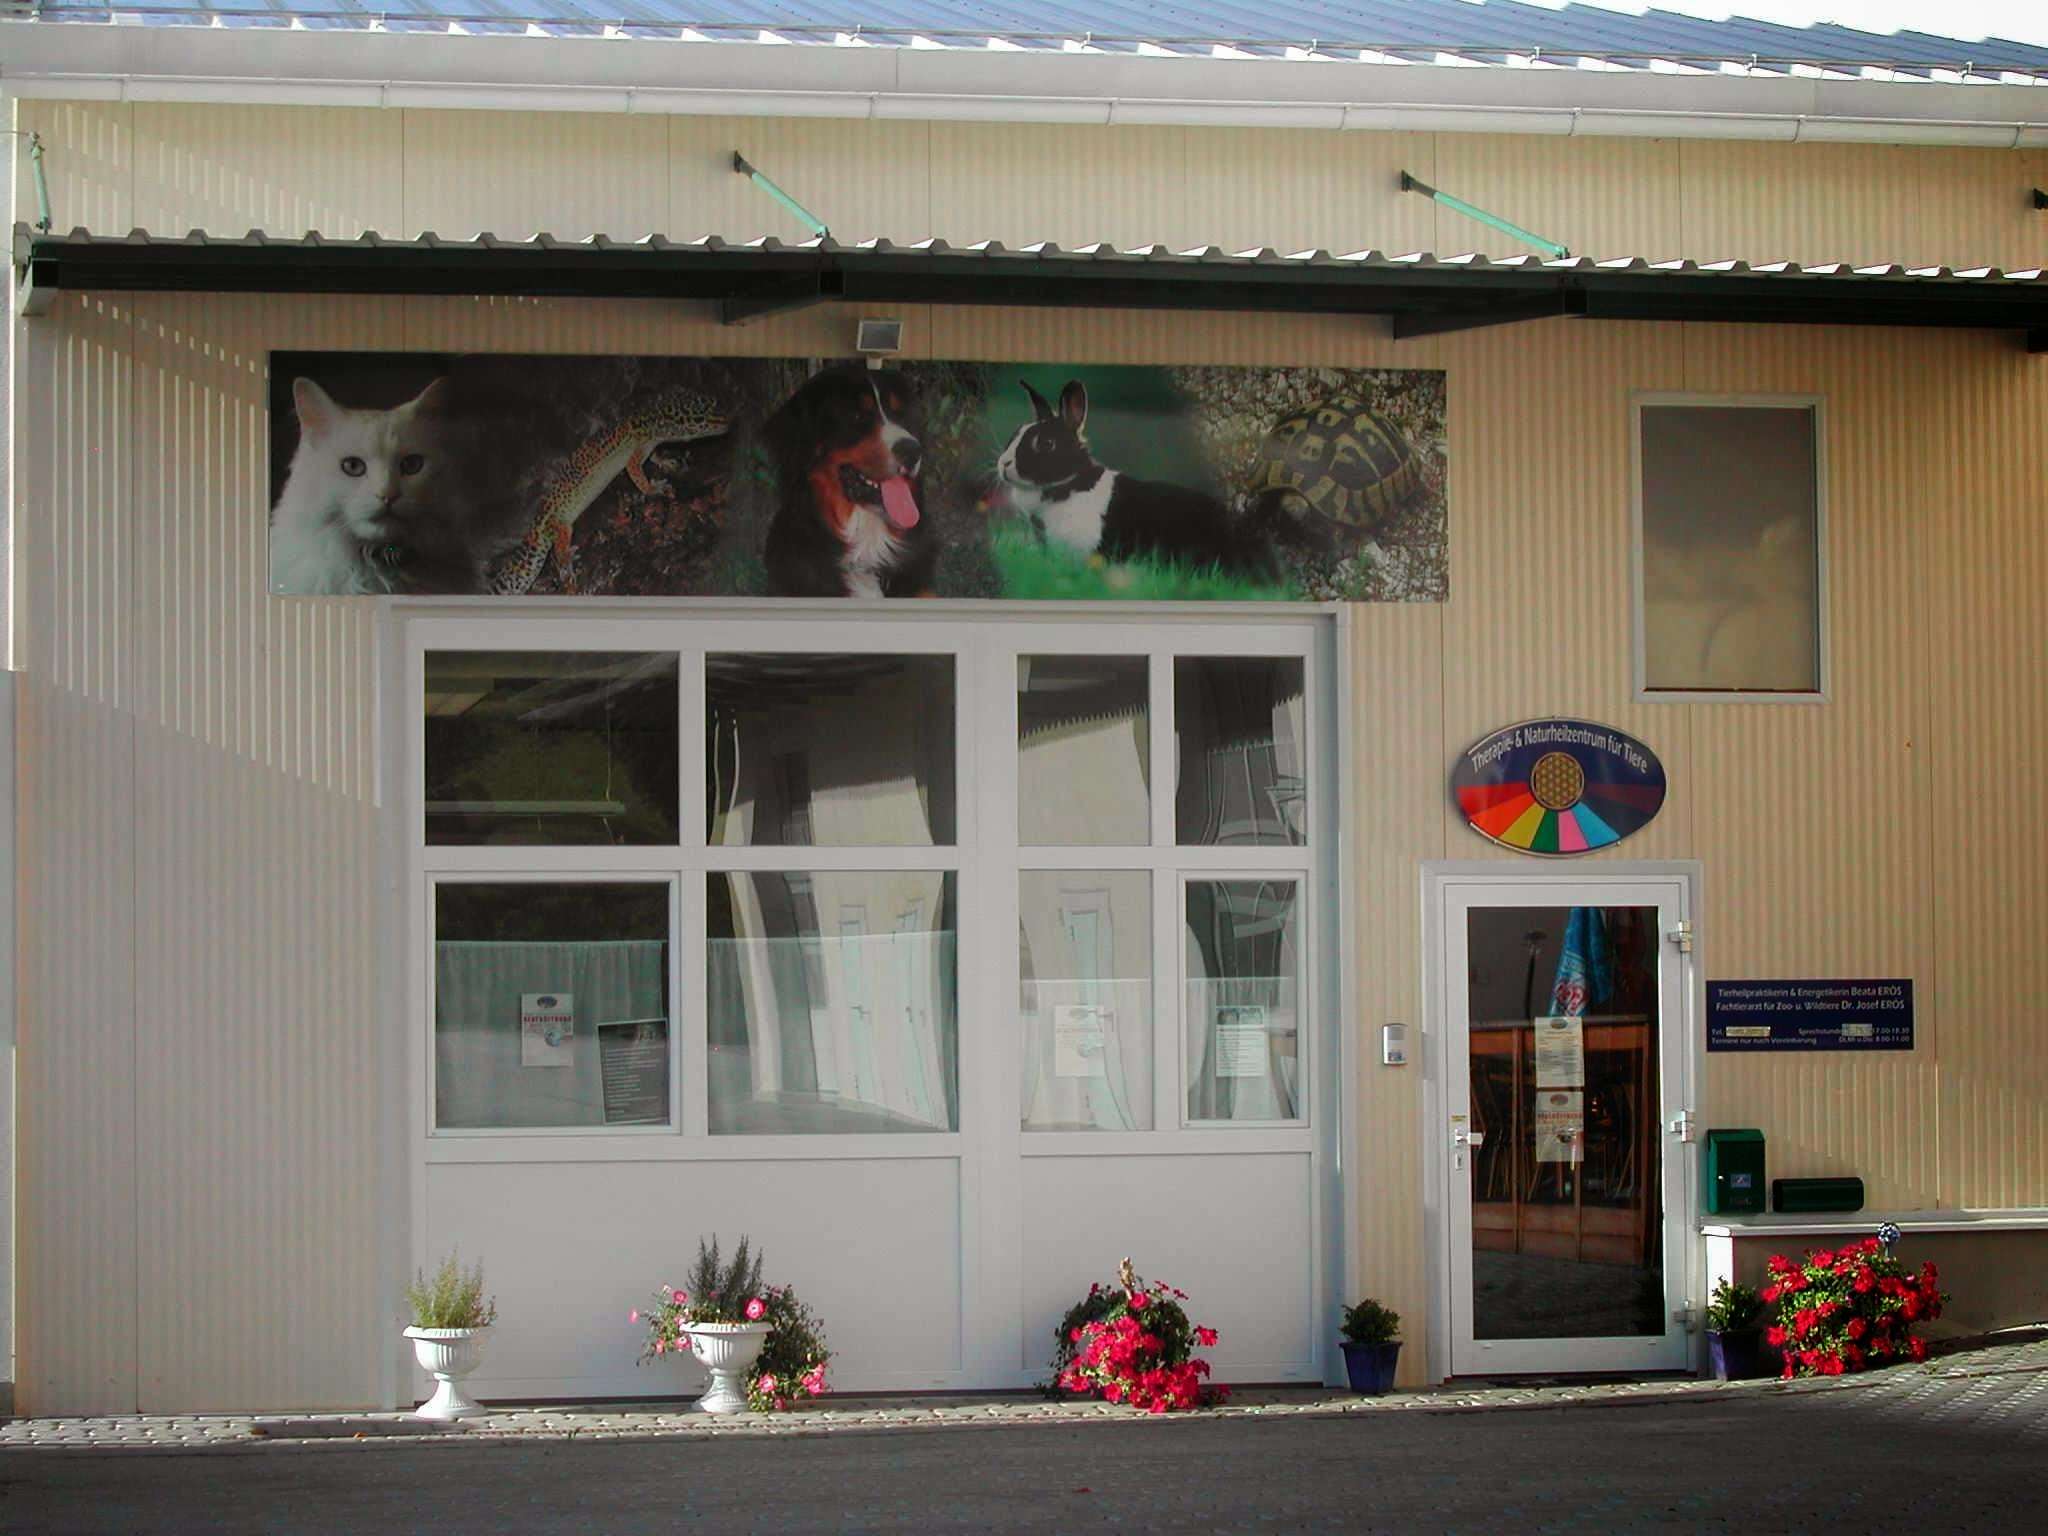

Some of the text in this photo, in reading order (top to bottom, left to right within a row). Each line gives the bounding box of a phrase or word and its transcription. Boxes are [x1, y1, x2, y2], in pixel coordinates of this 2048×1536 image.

[1515, 730, 1522, 748] &
[1524, 725, 1607, 750] Naturheilzentrum
[1607, 735, 1622, 754] für
[1623, 743, 1648, 774] Tiere
[1789, 988, 1797, 997] &
[1841, 1001, 1854, 1010] Dr.
[1856, 1000, 1879, 1010] Josef
